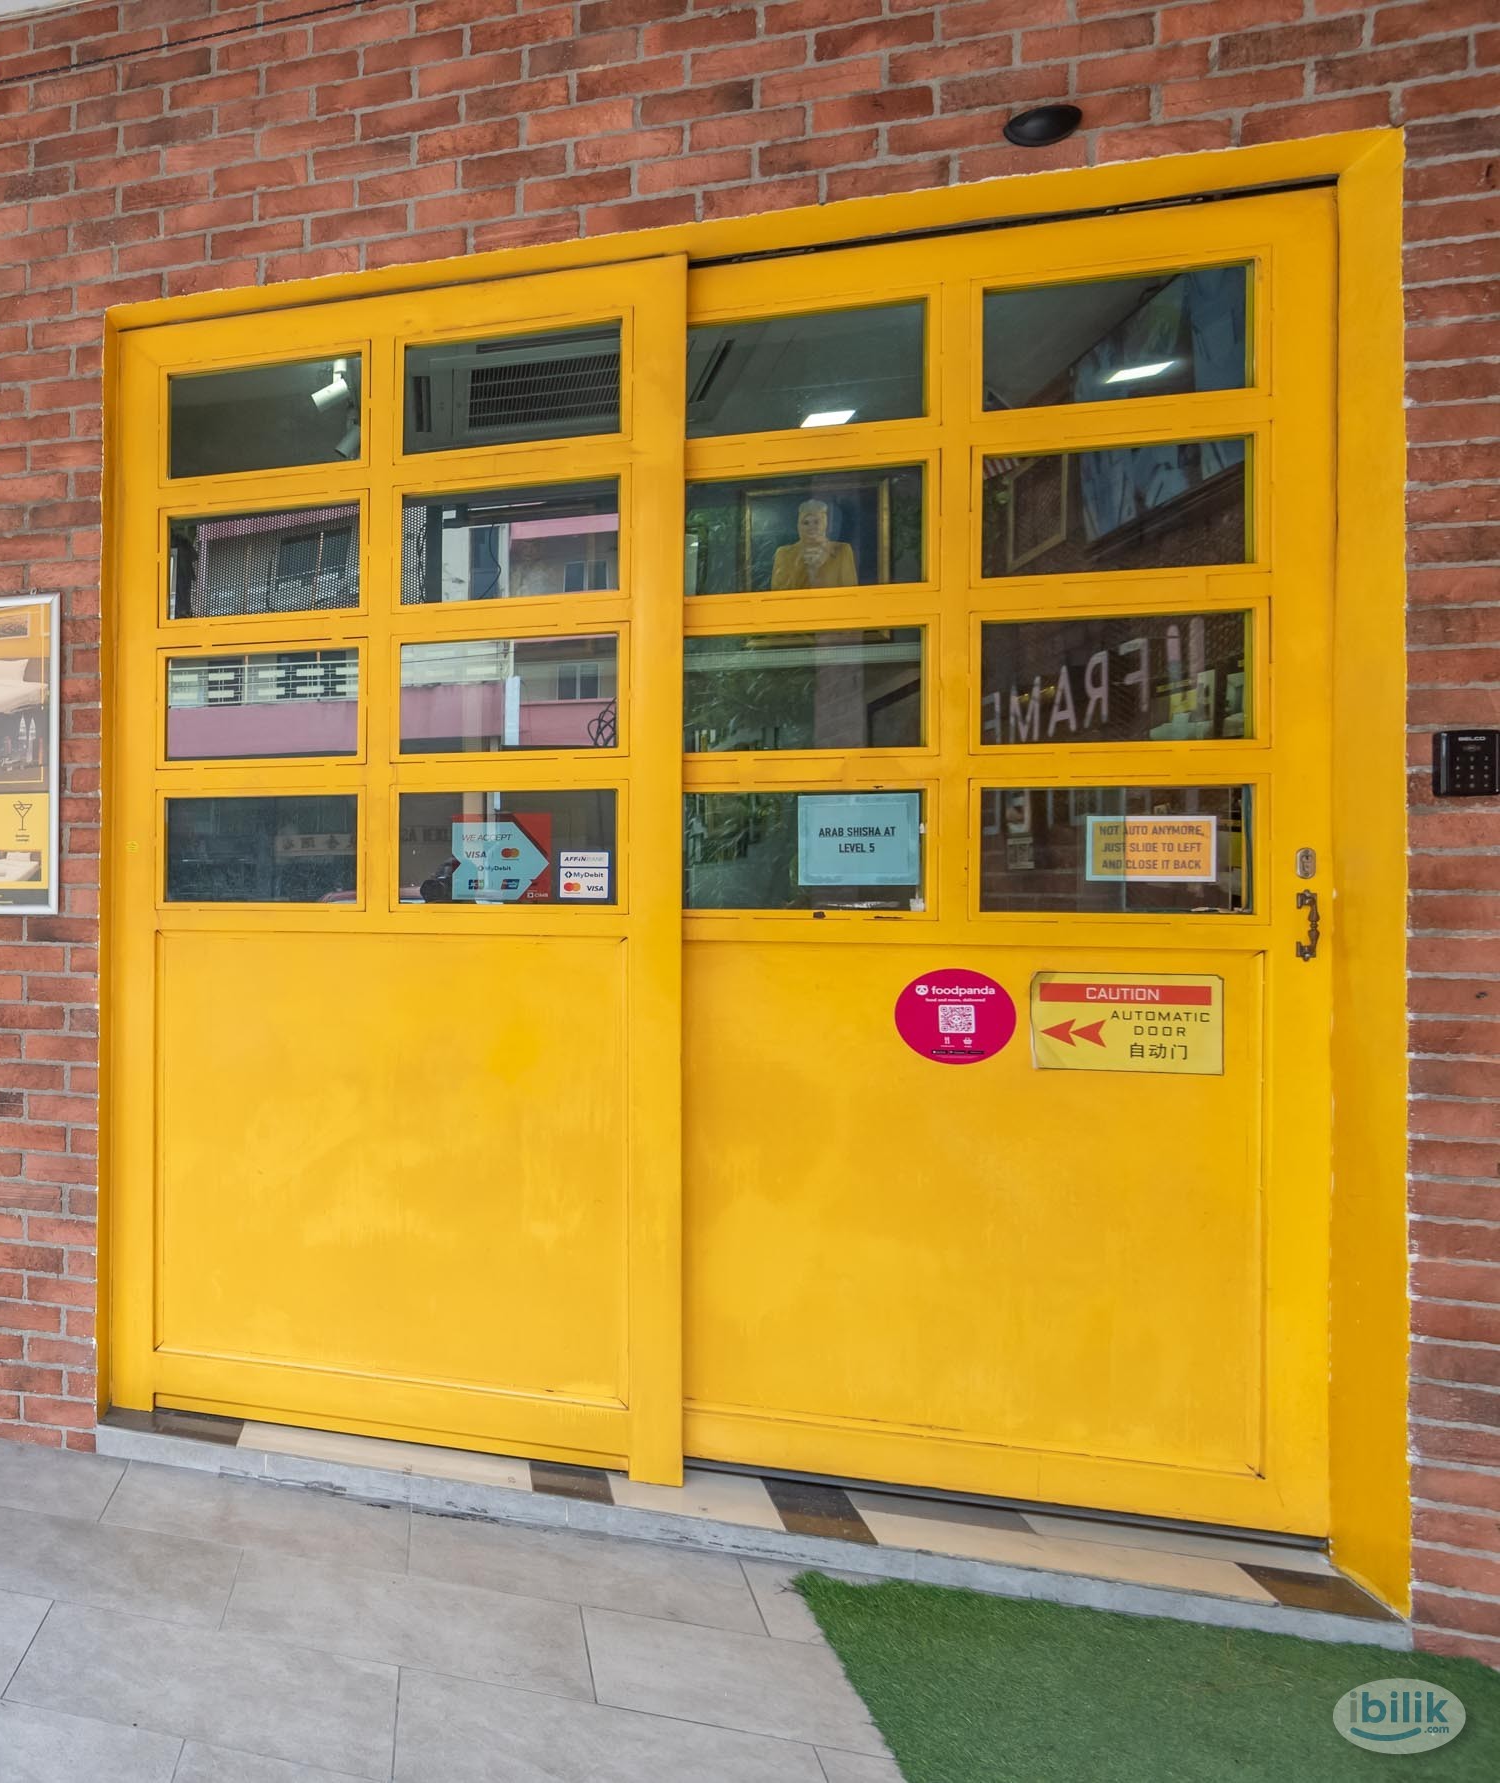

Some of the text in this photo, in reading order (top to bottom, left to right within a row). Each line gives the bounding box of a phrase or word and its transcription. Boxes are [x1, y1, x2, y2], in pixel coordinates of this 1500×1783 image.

[818, 827, 896, 837] ARAB SHISHA AT
[1100, 826, 1205, 837] NOT AUTO ANYMORE,
[839, 843, 875, 853] LEVEL 5
[1102, 842, 1201, 853] JUST SLIDE TO LEFT
[1102, 860, 1201, 869] AND CLOSE IT BACK
[932, 986, 995, 997] foodpanda
[1086, 988, 1160, 1001] CAUTION
[1110, 1010, 1210, 1023] AUTOMATIC
[1134, 1026, 1187, 1037] DOOR
[1130, 1043, 1188, 1060] 自动门
